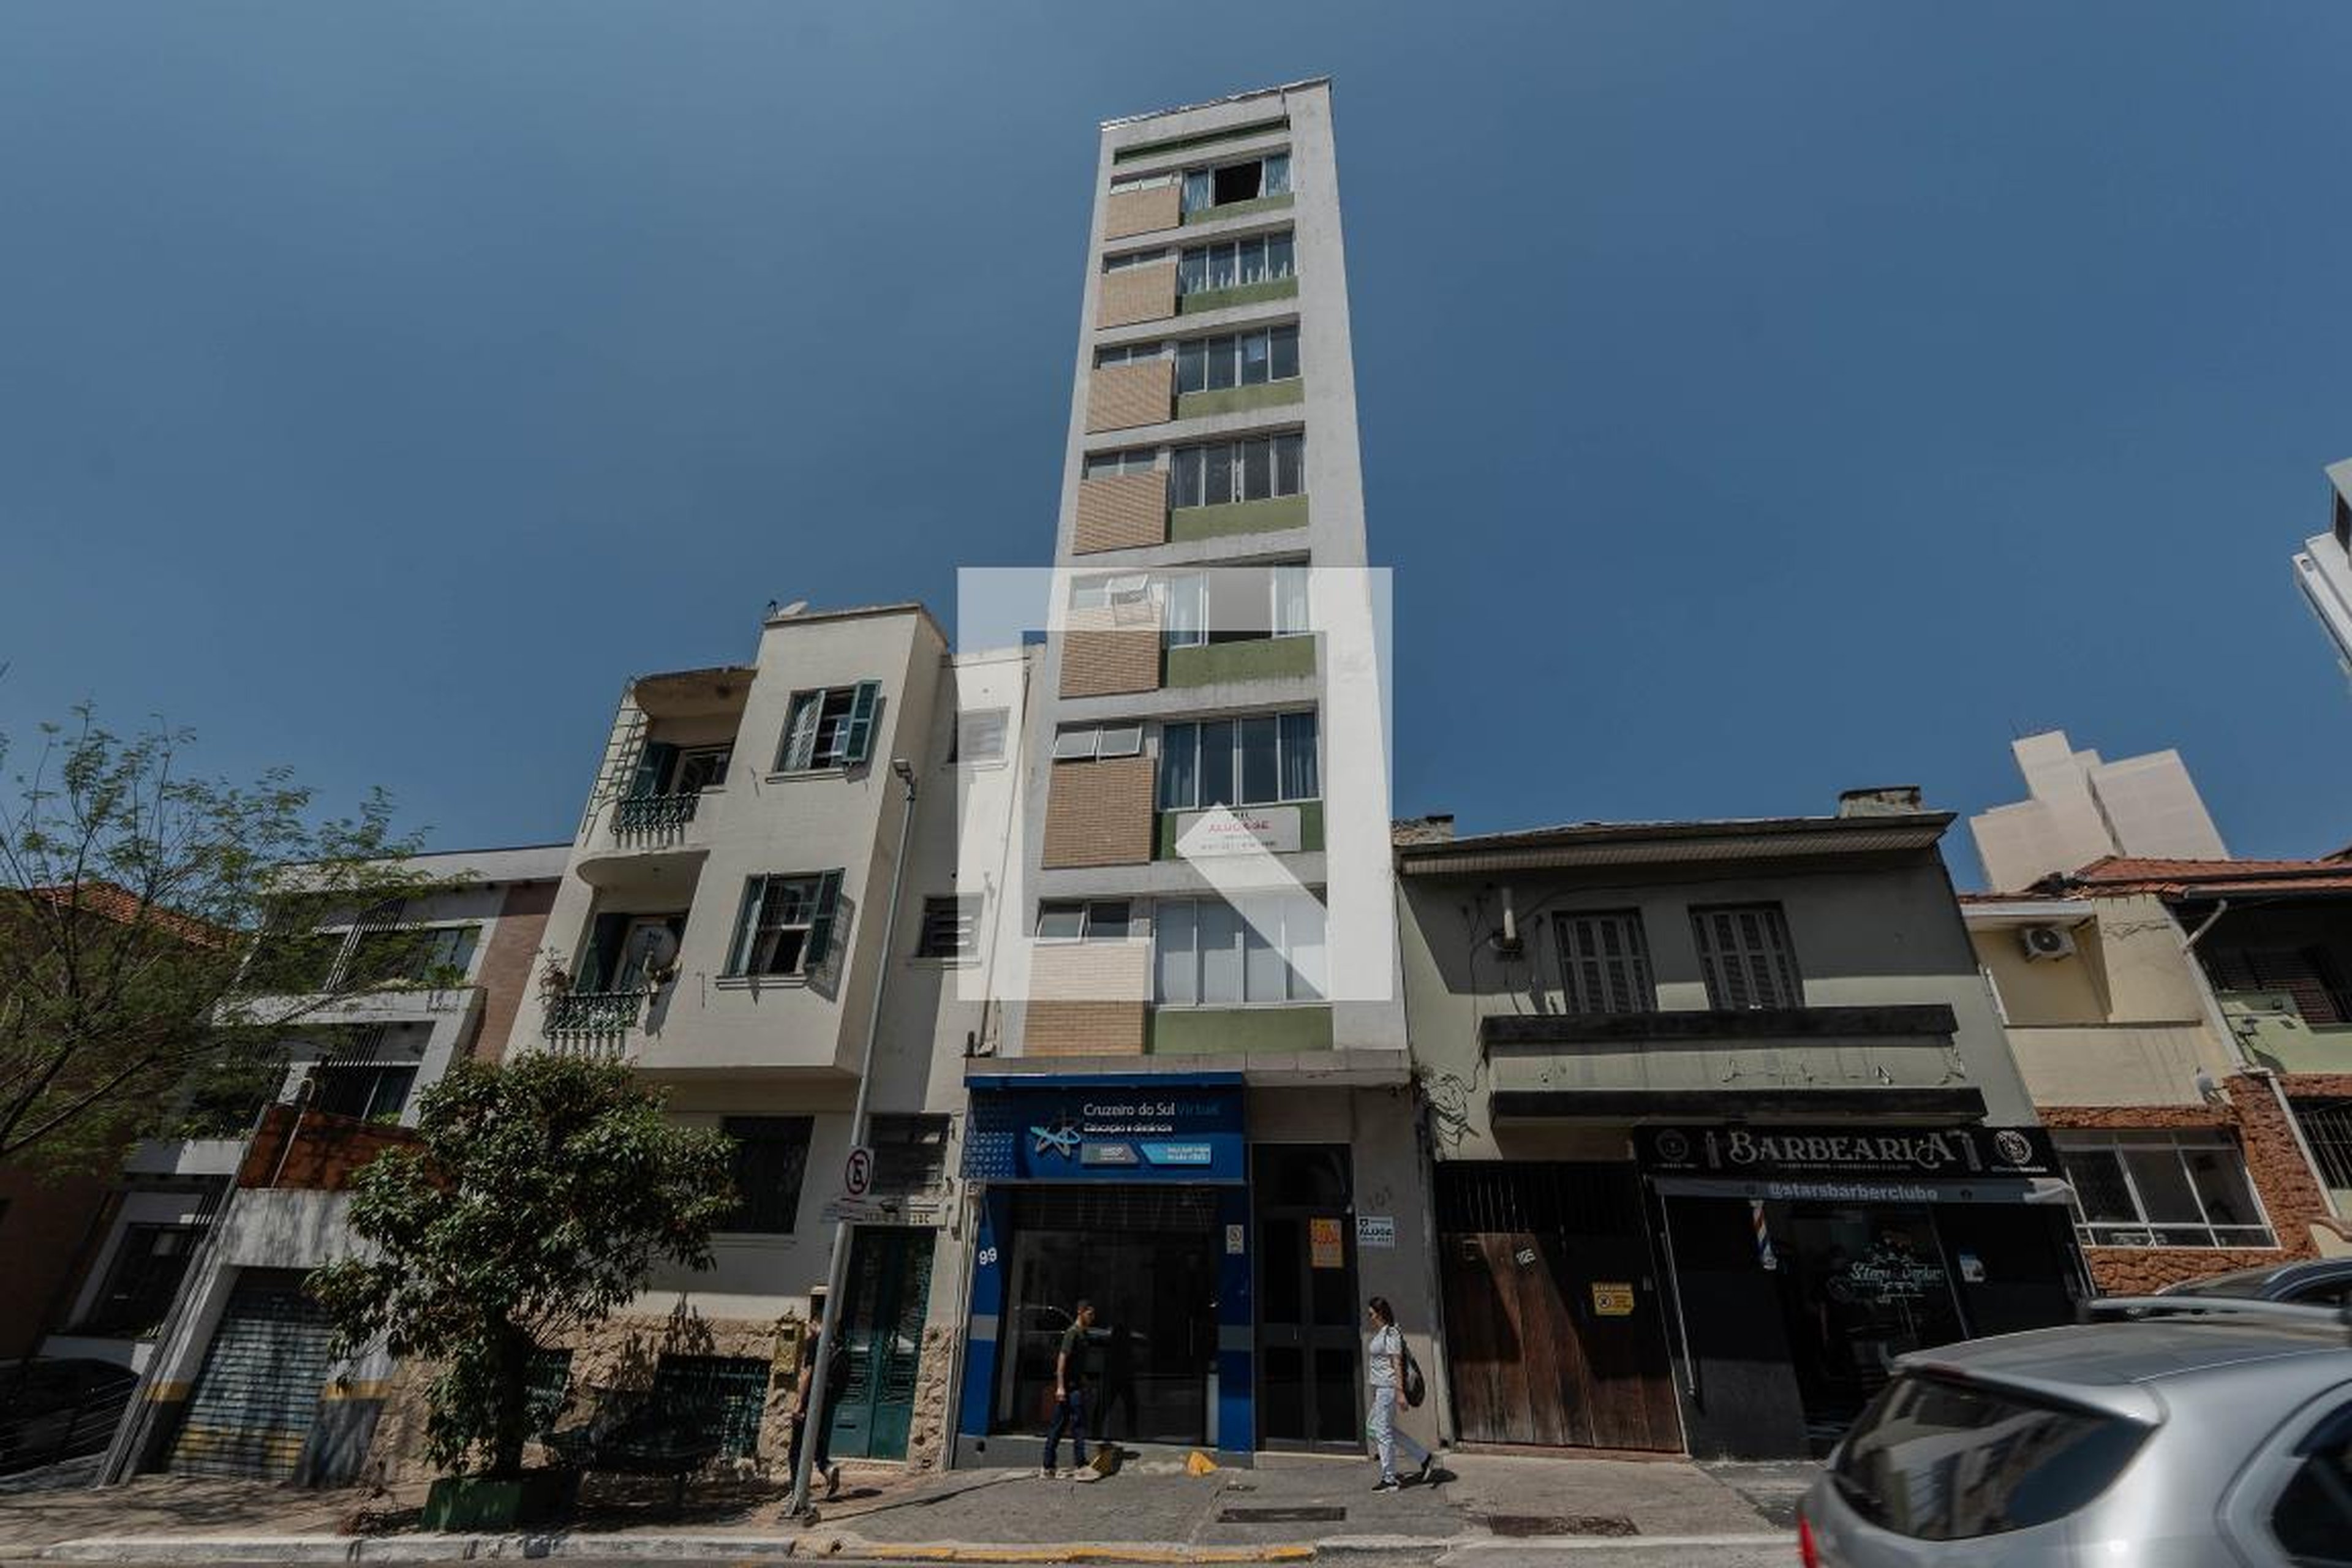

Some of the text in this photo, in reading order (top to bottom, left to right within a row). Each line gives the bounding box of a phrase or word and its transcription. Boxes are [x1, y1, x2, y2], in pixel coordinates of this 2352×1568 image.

[1083, 1103, 1135, 1117] Cruzeiro
[1138, 1102, 1155, 1117] do
[1156, 1101, 1176, 1117] Sul
[1728, 1129, 1957, 1168] BARBEARIA
[978, 1246, 1000, 1265] 99
